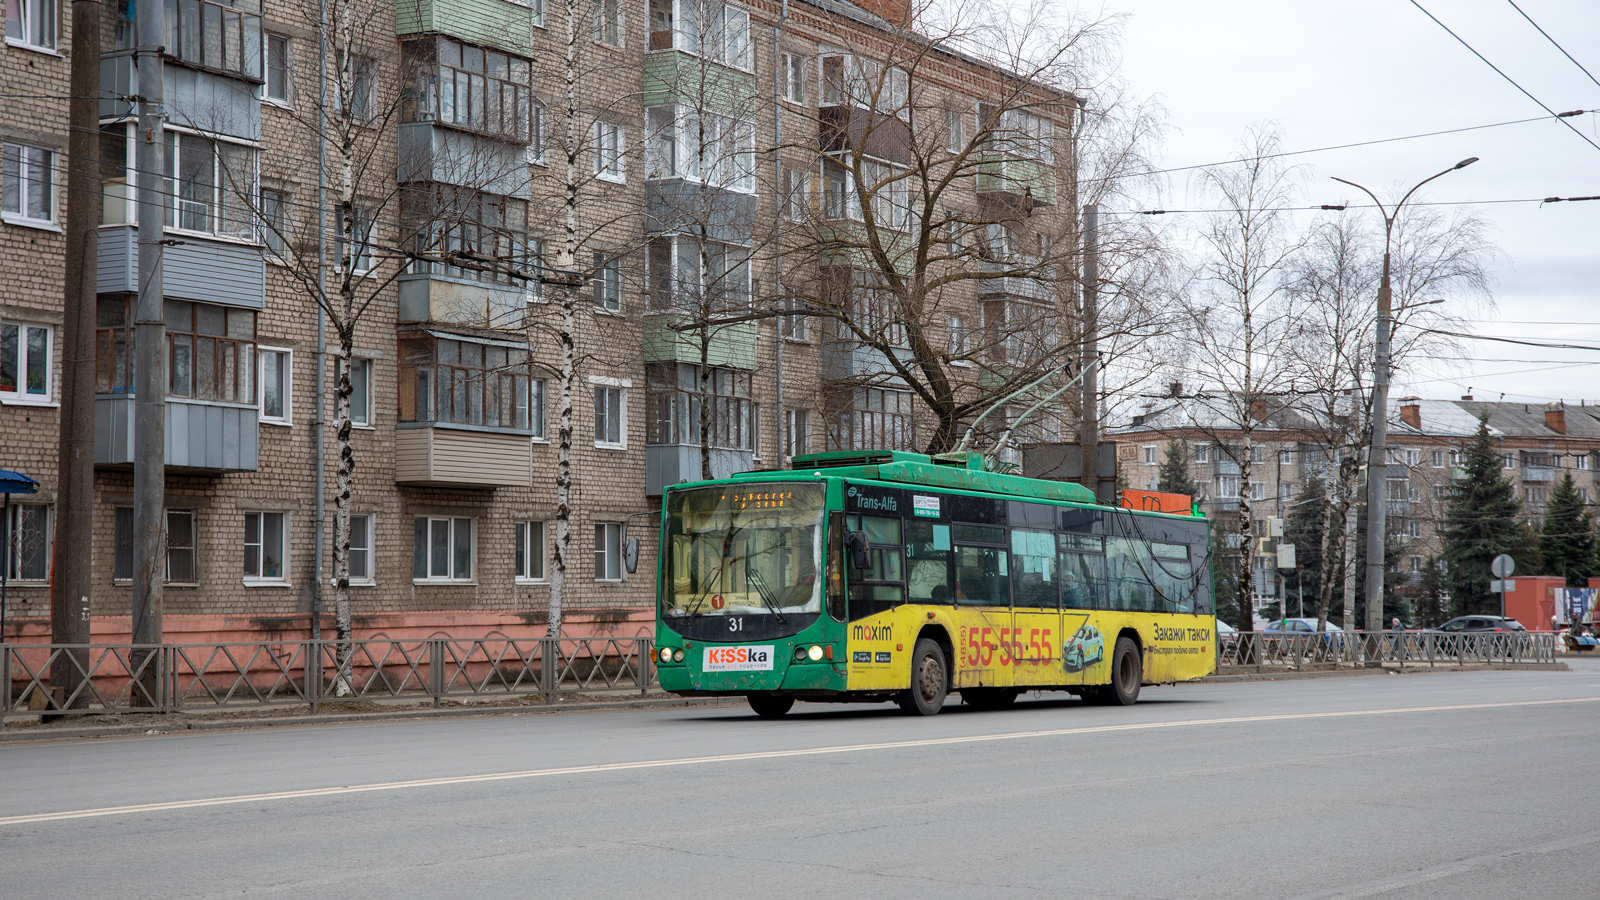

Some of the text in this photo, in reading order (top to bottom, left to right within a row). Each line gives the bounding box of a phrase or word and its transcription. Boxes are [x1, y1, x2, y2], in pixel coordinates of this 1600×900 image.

[857, 494, 897, 512] Trans-Alfa
[906, 543, 915, 558] 31
[713, 594, 721, 608] 1
[728, 617, 743, 632] 31
[853, 620, 892, 641] maxim
[1153, 622, 1210, 642] Закажи такси
[959, 625, 967, 669] (4855)
